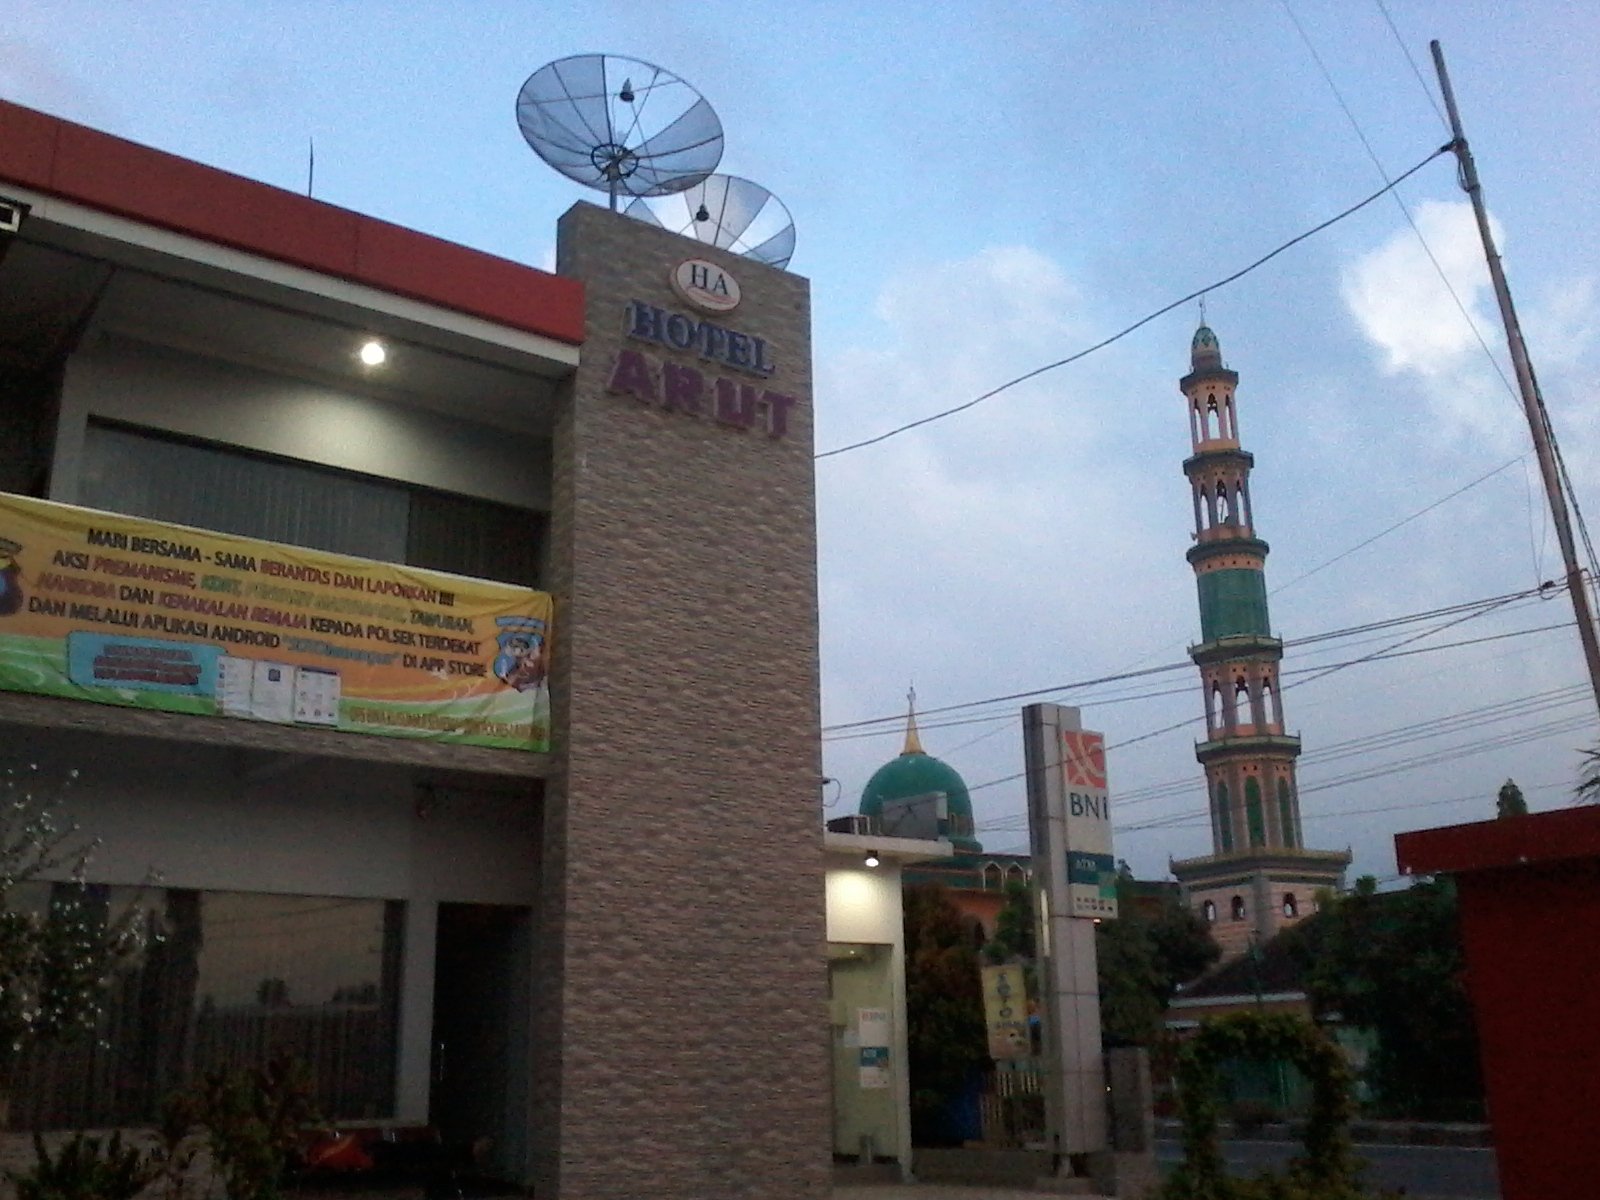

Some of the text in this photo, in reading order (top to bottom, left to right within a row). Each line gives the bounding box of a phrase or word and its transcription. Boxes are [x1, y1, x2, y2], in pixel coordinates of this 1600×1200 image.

[692, 264, 728, 295] HA
[624, 299, 775, 377] HOTEL
[606, 350, 796, 436] ARUT
[53, 550, 89, 570] AKSI
[87, 528, 128, 550] MARI
[131, 537, 202, 562] BERSAMA
[214, 551, 257, 572] SAMA
[260, 559, 331, 585] BERANTAS
[334, 571, 364, 592] DAN
[367, 577, 436, 604] LAPORKAN
[28, 596, 66, 617] DAN
[69, 602, 138, 628] MELALUI
[141, 614, 208, 638] APLIKASI
[211, 625, 280, 648] ANDROID
[403, 654, 415, 668] DI
[419, 657, 446, 673] APP
[119, 585, 154, 605] DAN
[158, 591, 249, 620] KENAKALAN
[310, 617, 363, 639] KEPADA
[367, 625, 416, 648] POLSEK
[419, 635, 482, 656] TERDEKAT
[1070, 793, 1109, 821] BNI
